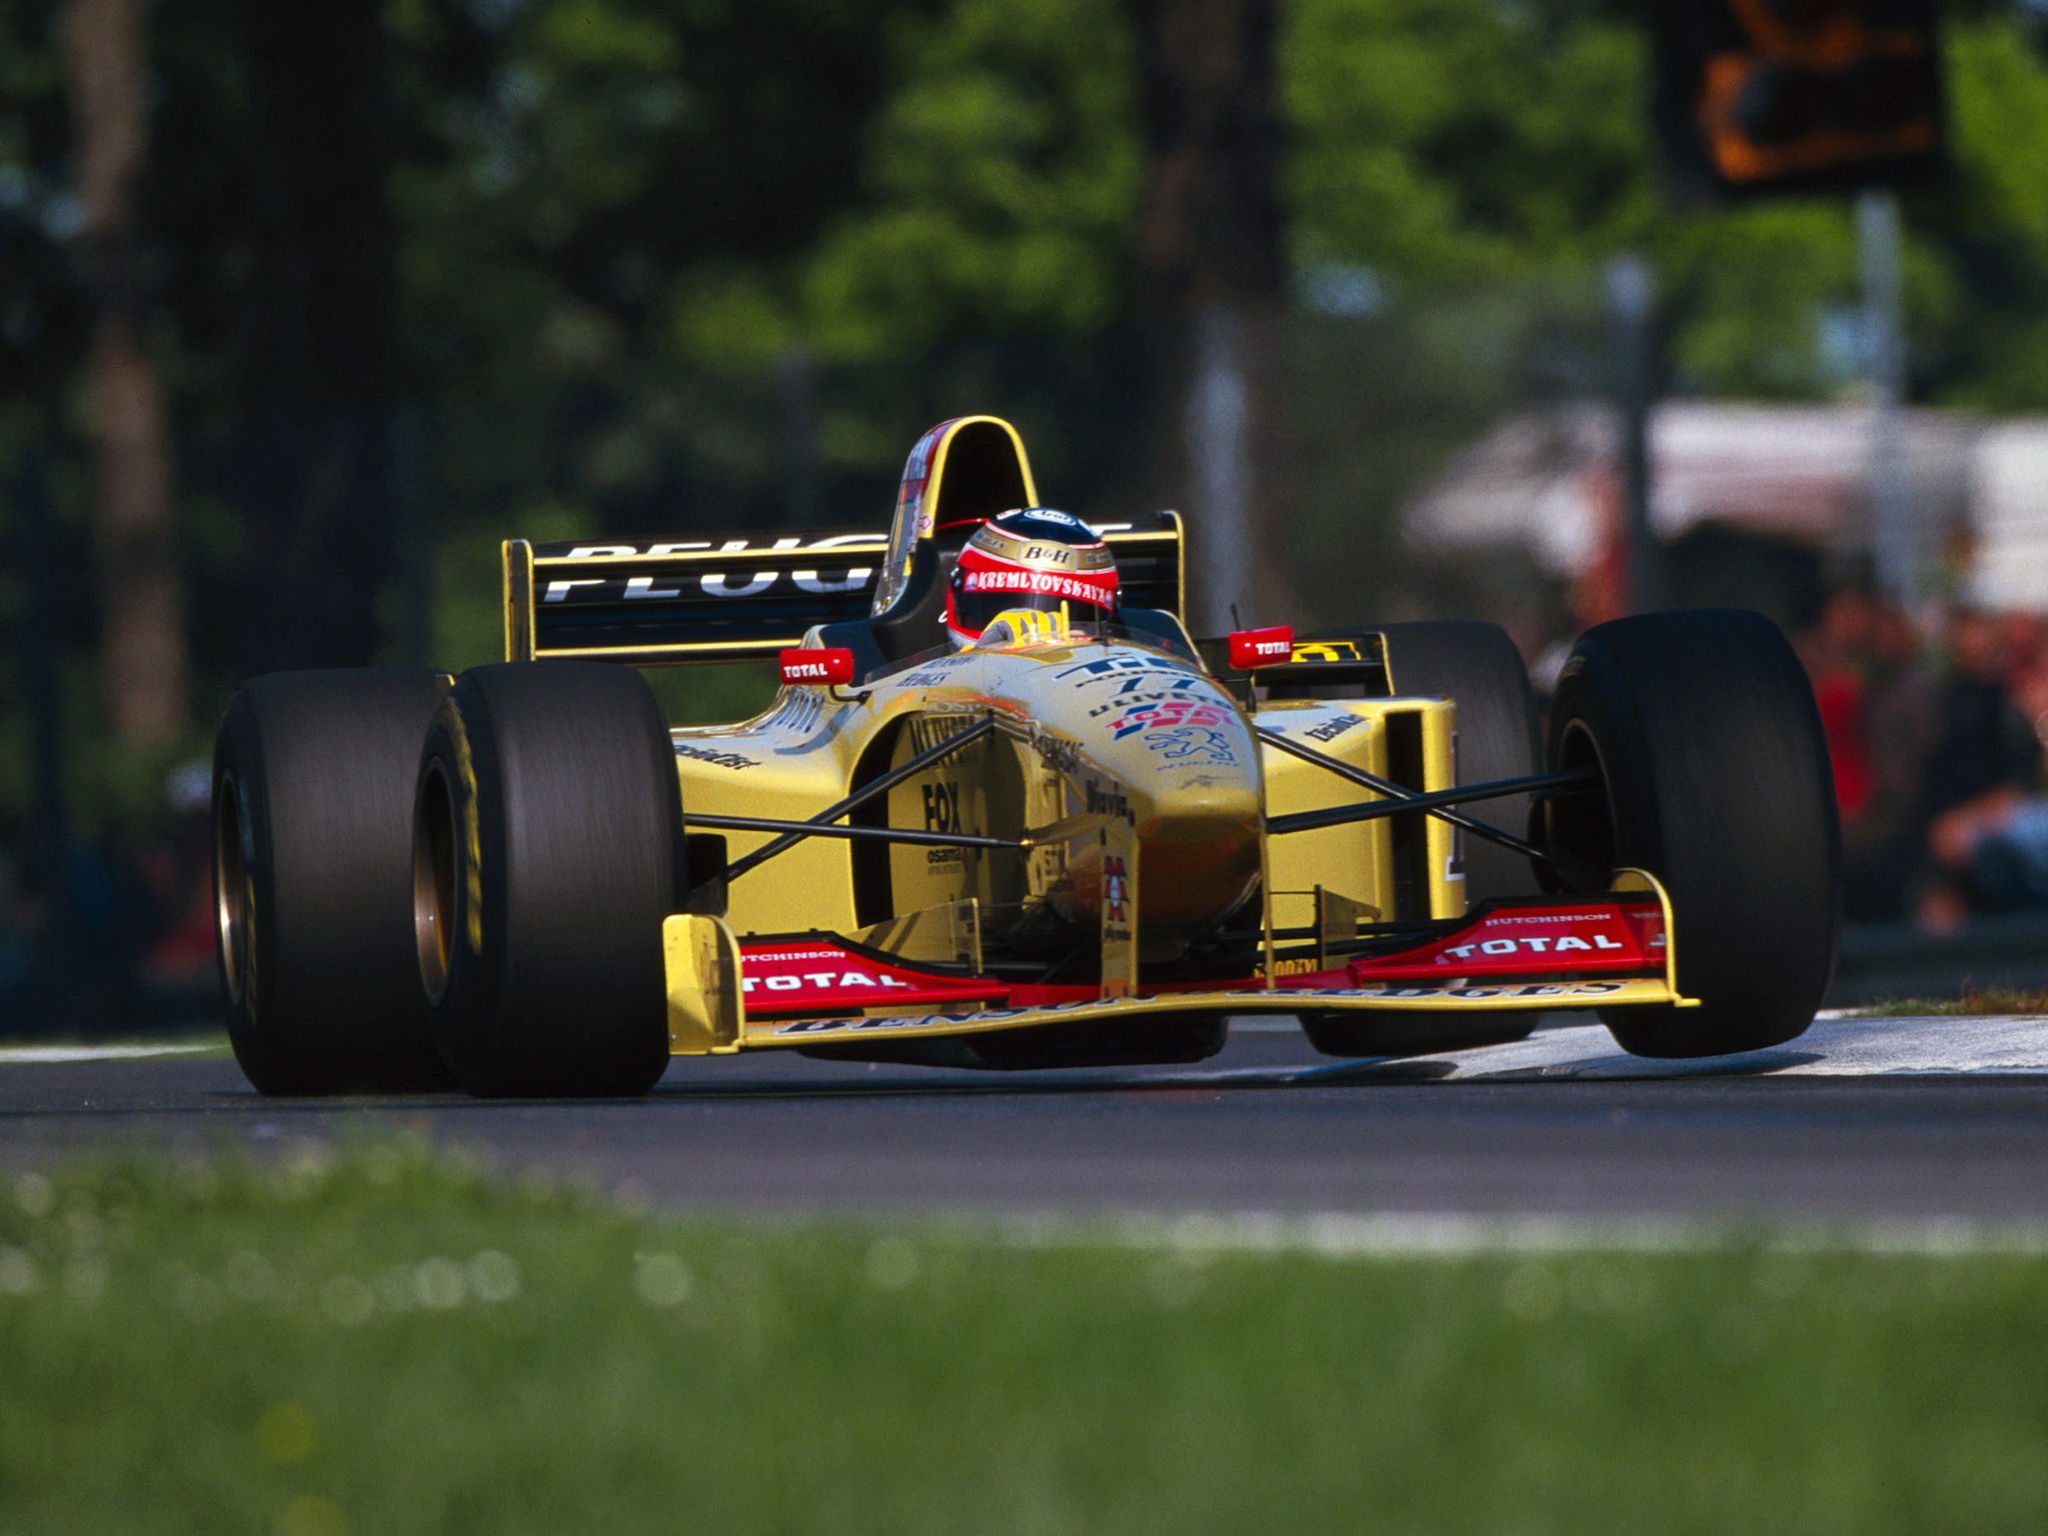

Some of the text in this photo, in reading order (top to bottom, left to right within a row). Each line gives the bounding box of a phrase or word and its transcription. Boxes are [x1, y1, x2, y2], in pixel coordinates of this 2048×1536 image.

[1024, 546, 1071, 564] B&H
[1255, 641, 1291, 655] TOTAL
[783, 663, 828, 678] TOTAL
[1105, 709, 1242, 730] TOTAL
[922, 781, 961, 834] FOX
[1485, 913, 1612, 927] HUTCHINSON
[1443, 934, 1624, 958] TOTAL
[742, 971, 909, 993] TOTAL
